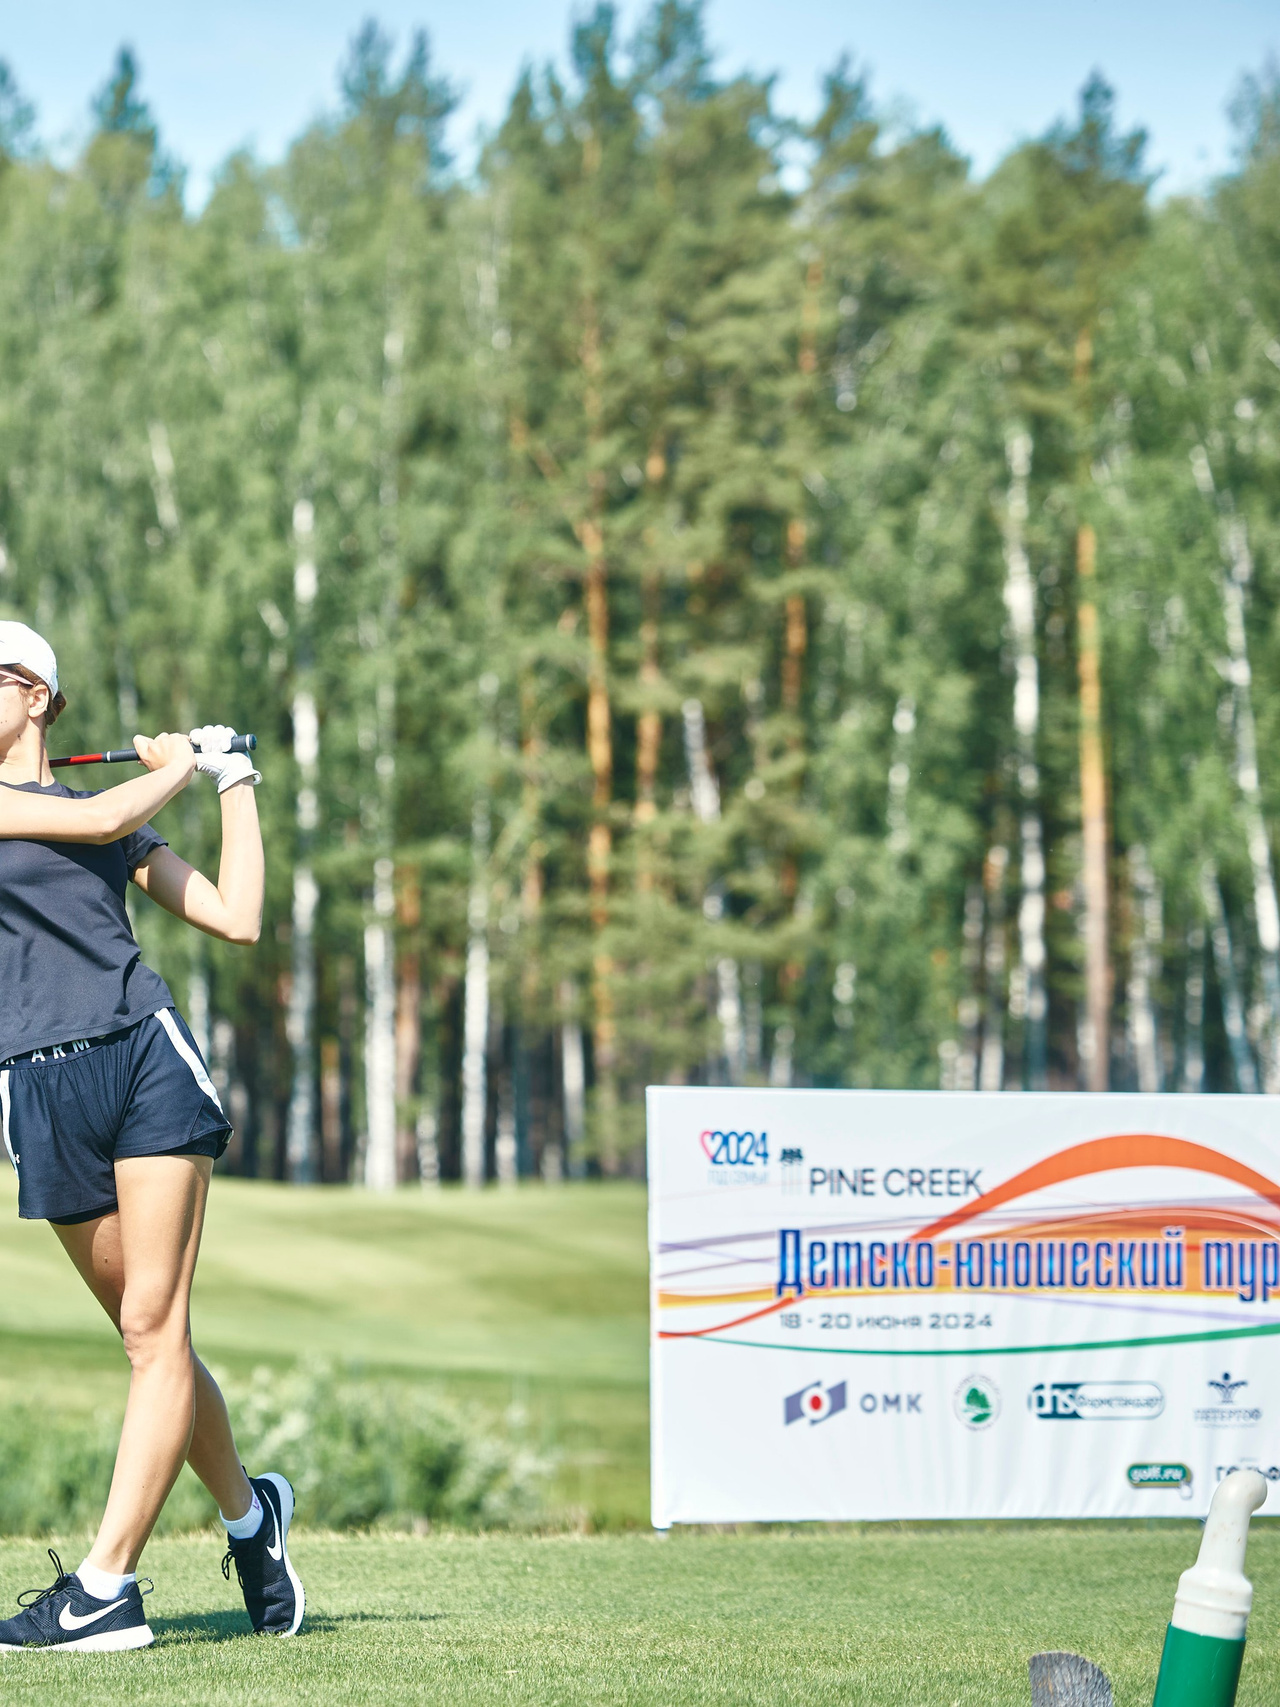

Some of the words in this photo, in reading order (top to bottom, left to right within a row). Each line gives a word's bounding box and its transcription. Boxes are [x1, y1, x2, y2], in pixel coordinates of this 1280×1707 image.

[31, 1035, 106, 1063] ARM
[710, 1131, 770, 1166] 2024
[809, 1167, 876, 1197] PINE
[883, 1167, 985, 1198] CREEK
[775, 1228, 1183, 1298] Детско-юношеский
[1204, 1241, 1279, 1303] тур
[780, 1313, 801, 1329] 18
[821, 1313, 852, 1330] 20
[929, 1313, 993, 1330] 2024
[859, 1392, 923, 1414] ОМК
[1131, 1465, 1183, 1484] golf.ru
